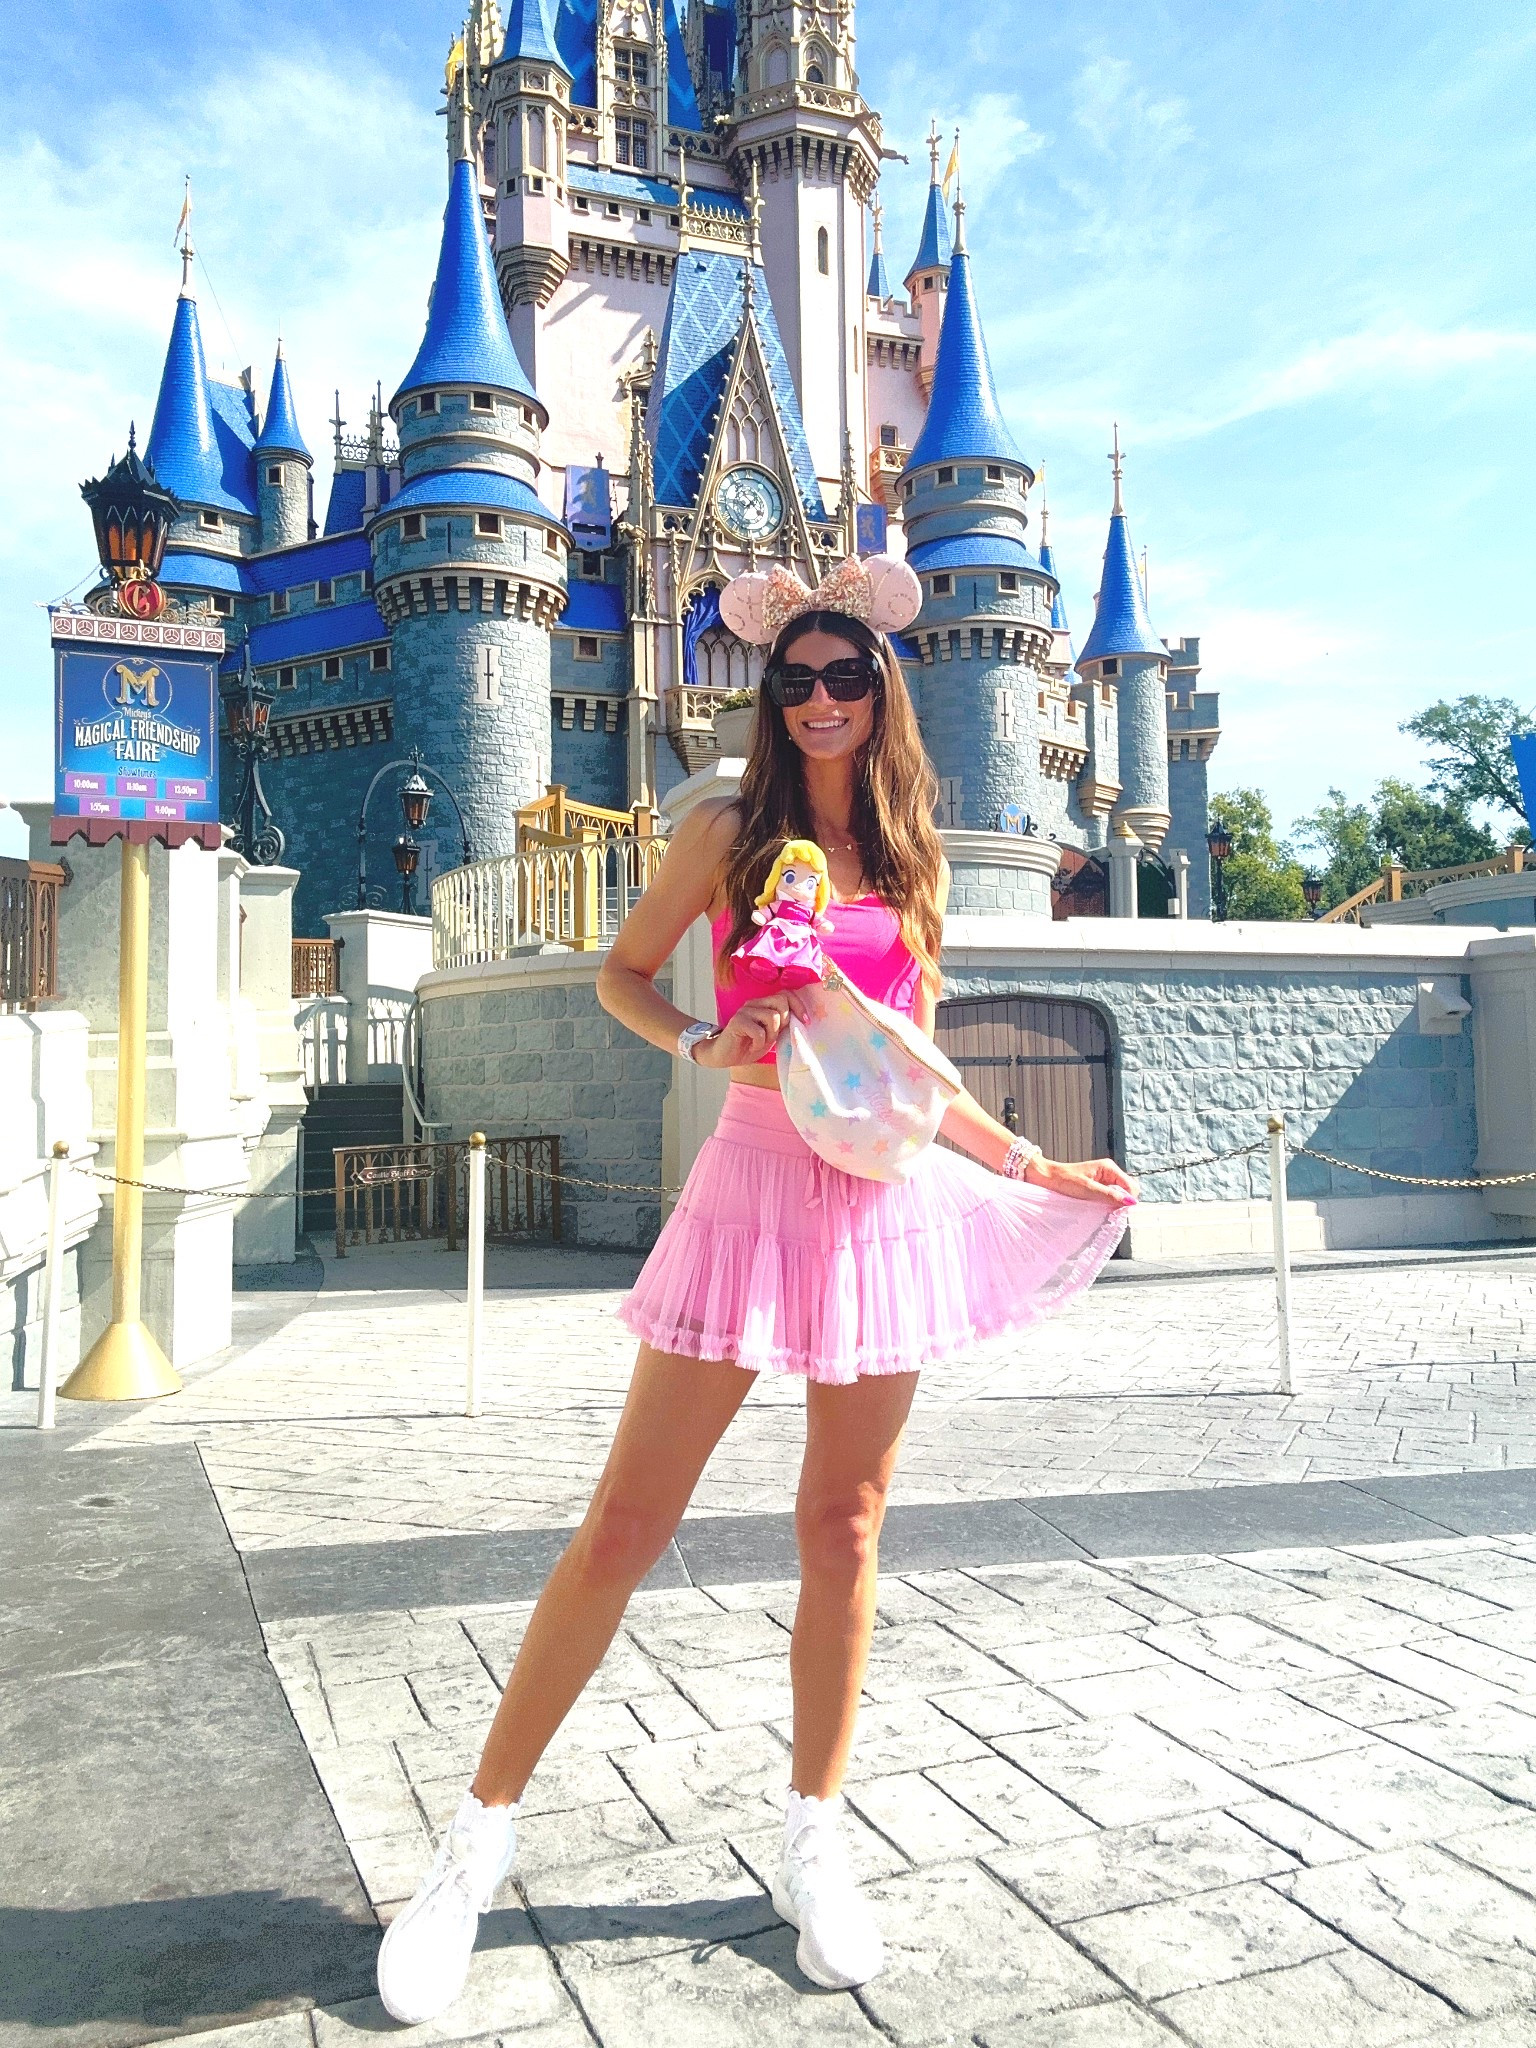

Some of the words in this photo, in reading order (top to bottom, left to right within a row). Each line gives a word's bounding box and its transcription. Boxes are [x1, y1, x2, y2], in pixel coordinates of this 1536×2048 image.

[116, 664, 160, 707] M
[122, 706, 152, 721] Mickey's
[74, 719, 128, 747] MAGICAL
[130, 719, 200, 755] FRIENDSHIP
[115, 740, 161, 762] FAIRE
